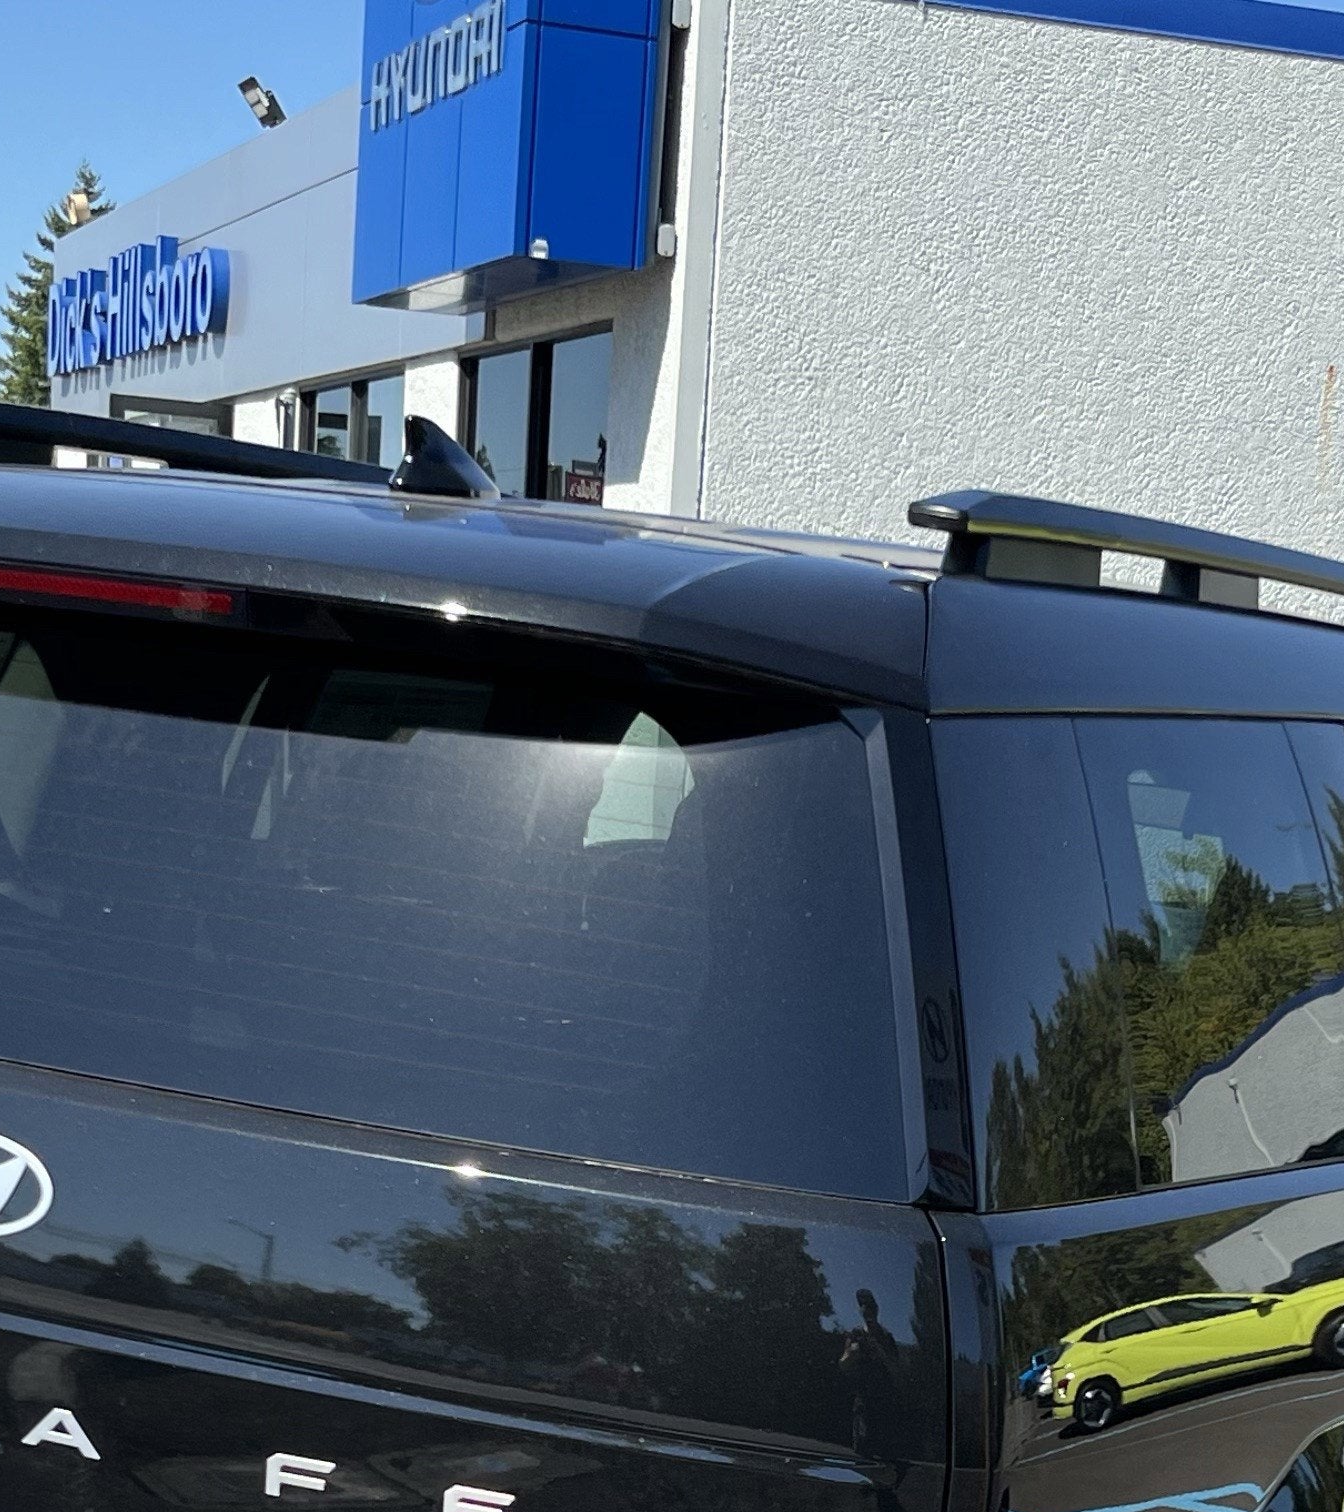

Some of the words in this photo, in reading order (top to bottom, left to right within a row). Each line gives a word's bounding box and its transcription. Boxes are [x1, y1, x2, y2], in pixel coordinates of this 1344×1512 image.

[370, 0, 503, 133] HYUNDAI
[48, 270, 104, 377] Dick's
[106, 234, 216, 361] Hillsboro
